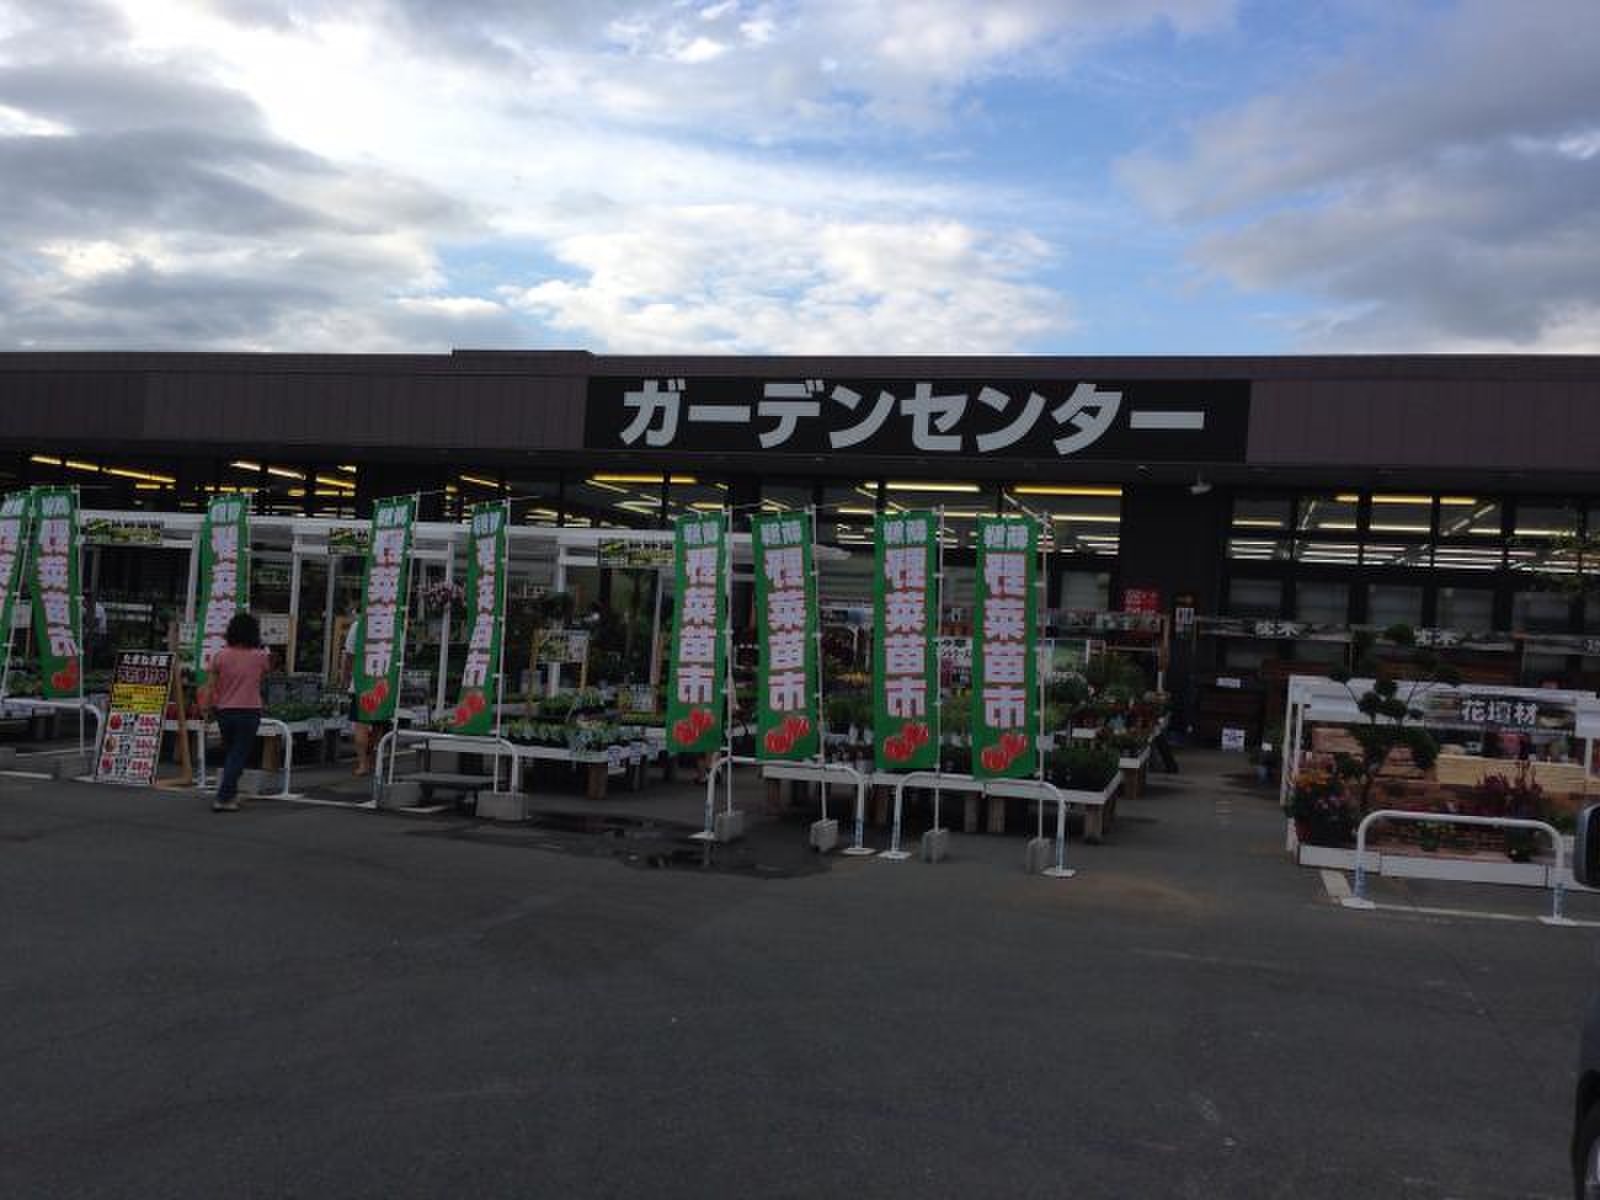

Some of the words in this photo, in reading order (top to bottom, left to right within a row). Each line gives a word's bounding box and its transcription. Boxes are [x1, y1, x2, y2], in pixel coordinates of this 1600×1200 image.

[619, 379, 1205, 455] ガーデンセンター
